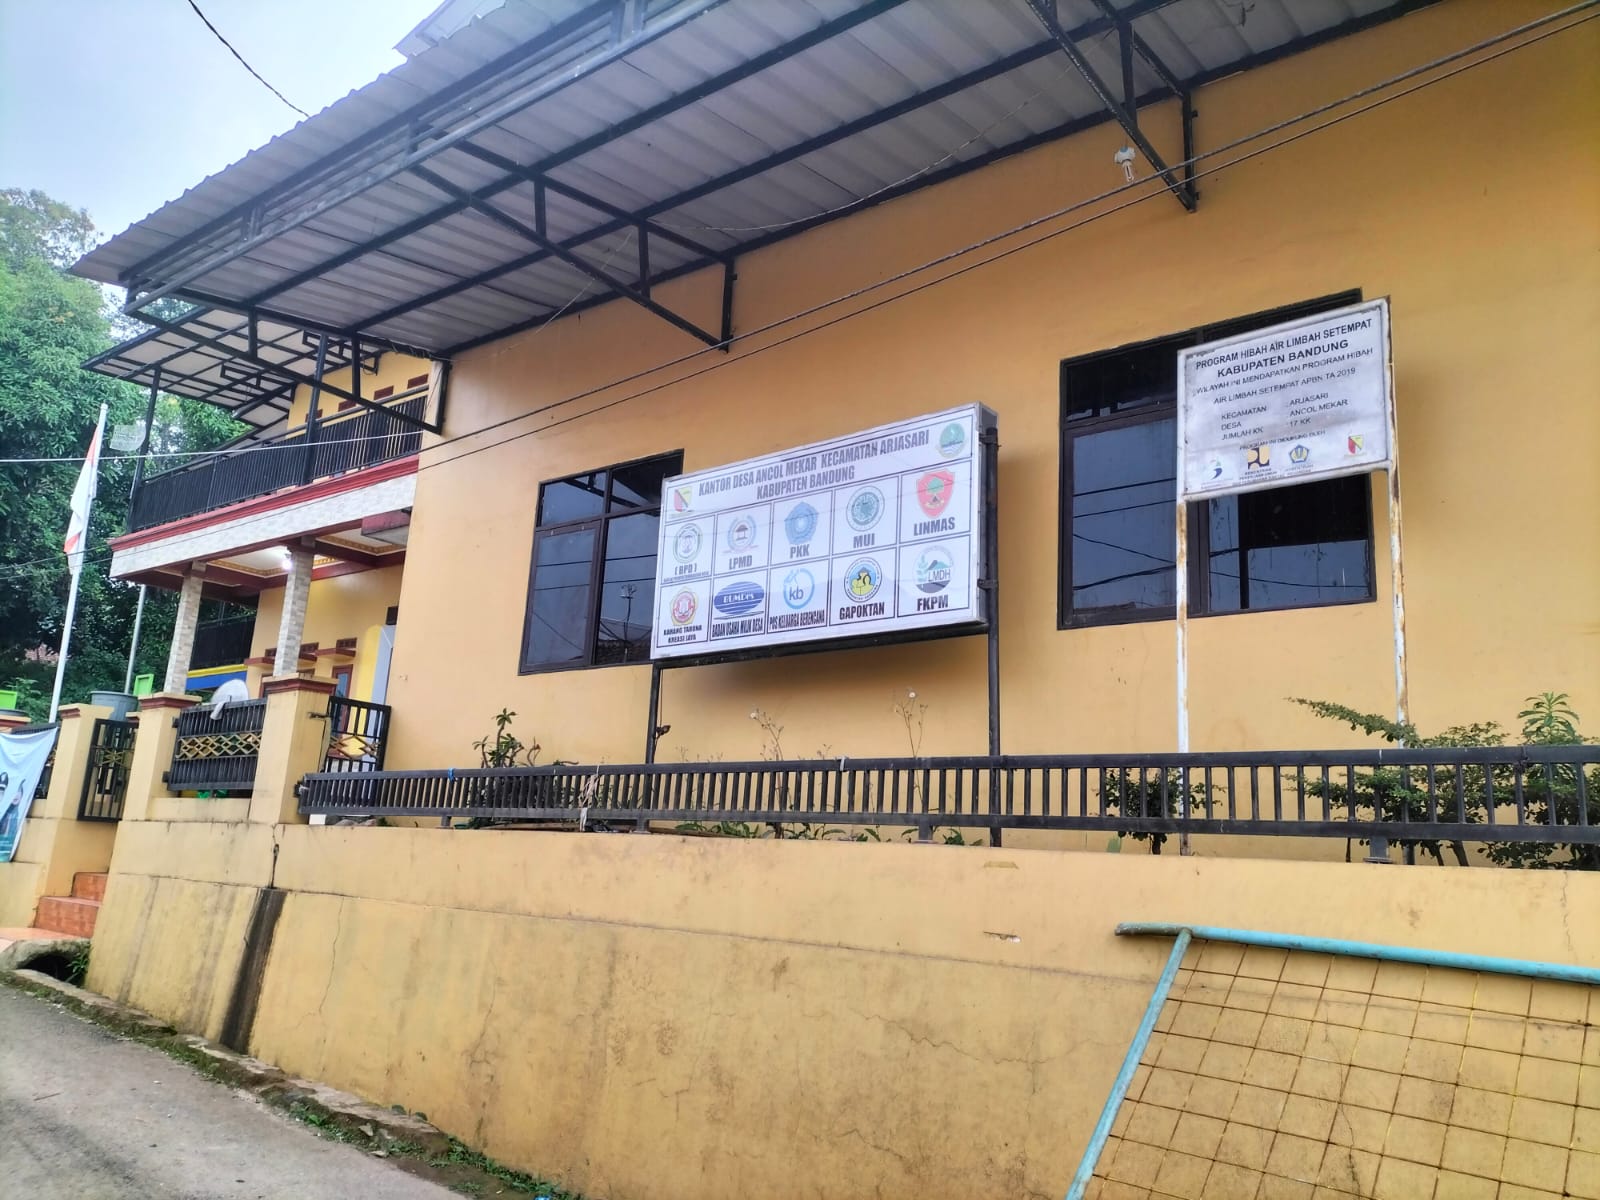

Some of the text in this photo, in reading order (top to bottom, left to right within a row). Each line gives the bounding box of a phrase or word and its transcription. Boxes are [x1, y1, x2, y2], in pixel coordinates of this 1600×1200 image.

[1196, 318, 1373, 370] PROGRAM HIBAH AIR LIMBAH SETEMPAT
[1217, 339, 1349, 378] KABUPATEN BANDUNG
[1196, 347, 1373, 395] WILAYAH INI MENDAPATKAN PROGRAM HIBAH
[1214, 367, 1356, 404] AIR LIMBAH SETEMPAT APBN TA 2019
[1221, 392, 1329, 420] KECAMATAN ARJASARI
[1221, 399, 1348, 431] DESA ANCOL MEKAR
[1222, 417, 1312, 440] JUMLAH KK 17 KK
[699, 429, 930, 497] KANTOR DESA ANCOL MEKAR KECAMATAN ARJASARI
[756, 465, 855, 500] KABUPATEN BANDUNG
[913, 516, 955, 536] LINMAS
[789, 544, 810, 559] PKK
[853, 533, 875, 549] MUI
[728, 555, 753, 570] LPMD
[927, 569, 951, 582] LMDH
[789, 586, 804, 601] kb
[917, 594, 949, 611] FKPM
[778, 612, 799, 629] KELUARGA
[799, 609, 825, 627] BERENCANA
[839, 602, 885, 620] GAPOKTAN
[711, 617, 763, 638] BADAN USAHA MILIK DESA
